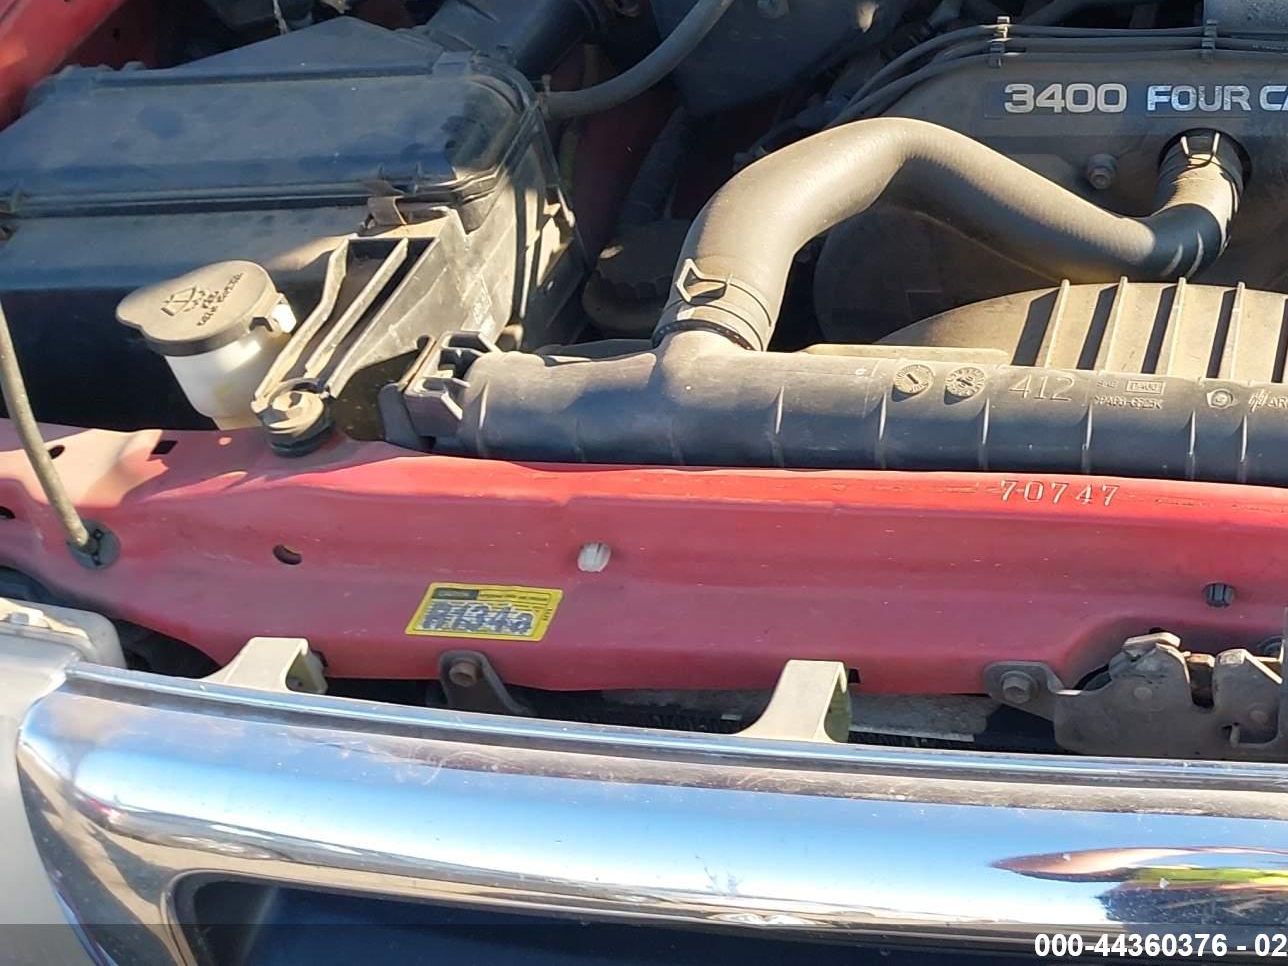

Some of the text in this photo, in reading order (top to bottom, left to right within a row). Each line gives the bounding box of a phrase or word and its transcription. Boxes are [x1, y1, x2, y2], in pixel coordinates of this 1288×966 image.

[1004, 83, 1127, 113] 3400
[1146, 85, 1251, 111] FOUR
[1009, 374, 1074, 401] 412
[1001, 480, 1120, 506] 70747
